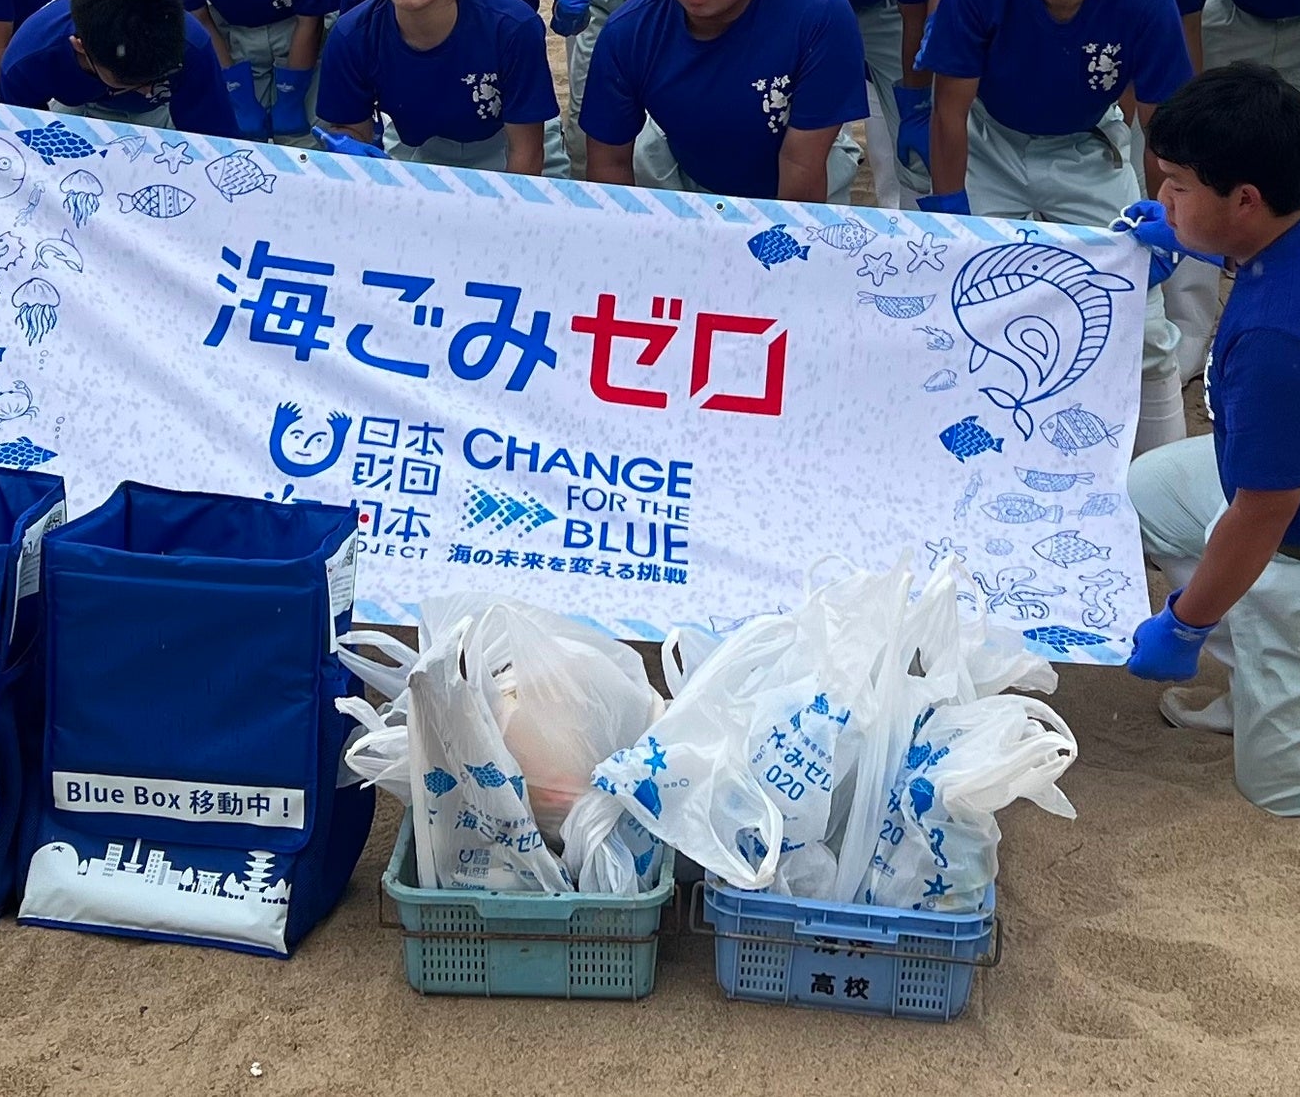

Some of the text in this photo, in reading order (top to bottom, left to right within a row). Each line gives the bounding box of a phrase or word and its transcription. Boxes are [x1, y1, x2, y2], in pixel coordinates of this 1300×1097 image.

[204, 240, 788, 416] 海ごみゼロ
[358, 416, 445, 457] 日本
[352, 453, 442, 497] 財団
[462, 427, 694, 498] CHANGE
[567, 485, 690, 523] FOR THE
[357, 540, 428, 560] OJECT
[564, 521, 689, 565] BLUE
[447, 543, 688, 585] 海の未来を変える挑戦
[66, 781, 125, 805] Blue
[134, 787, 181, 810] Box
[811, 972, 870, 1000] 高校
